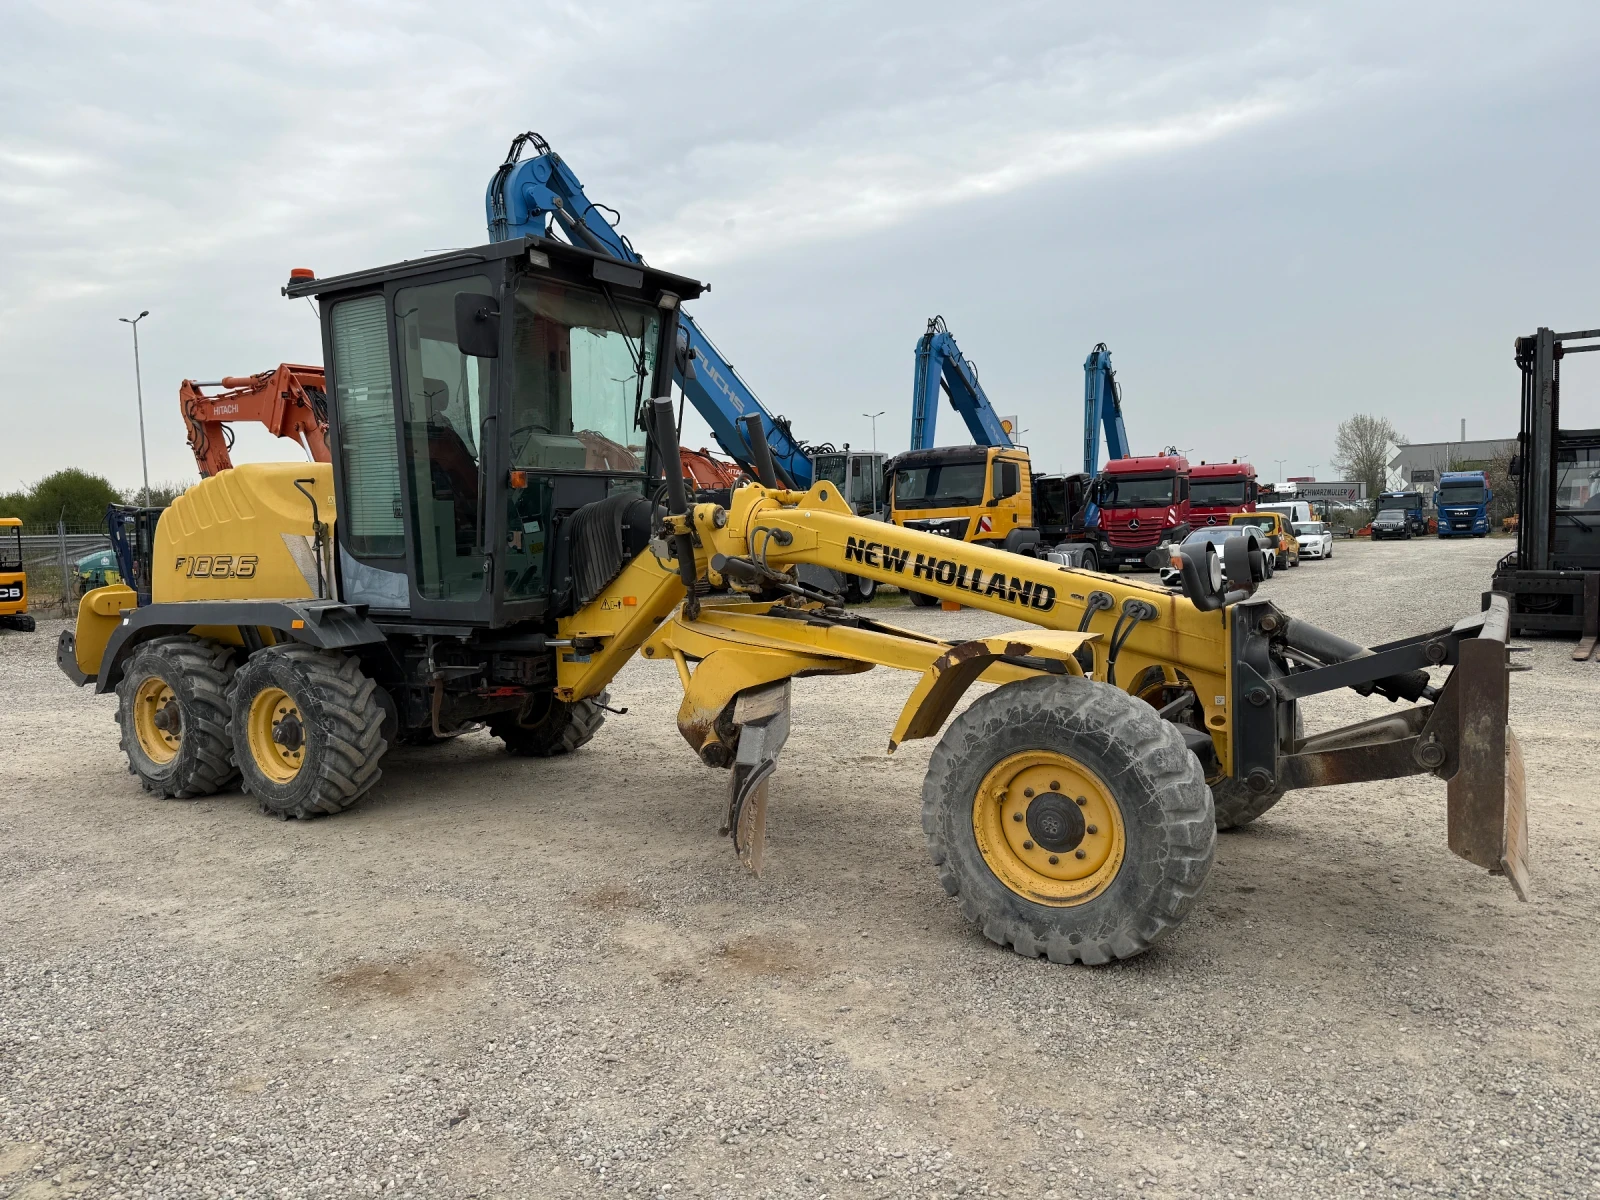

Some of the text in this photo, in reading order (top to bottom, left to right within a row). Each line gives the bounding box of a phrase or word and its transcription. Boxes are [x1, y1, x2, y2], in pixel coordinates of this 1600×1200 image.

[213, 404, 239, 416] HITACHI
[694, 345, 745, 414] FUCHS
[845, 536, 1056, 612] NEW HOLLAND
